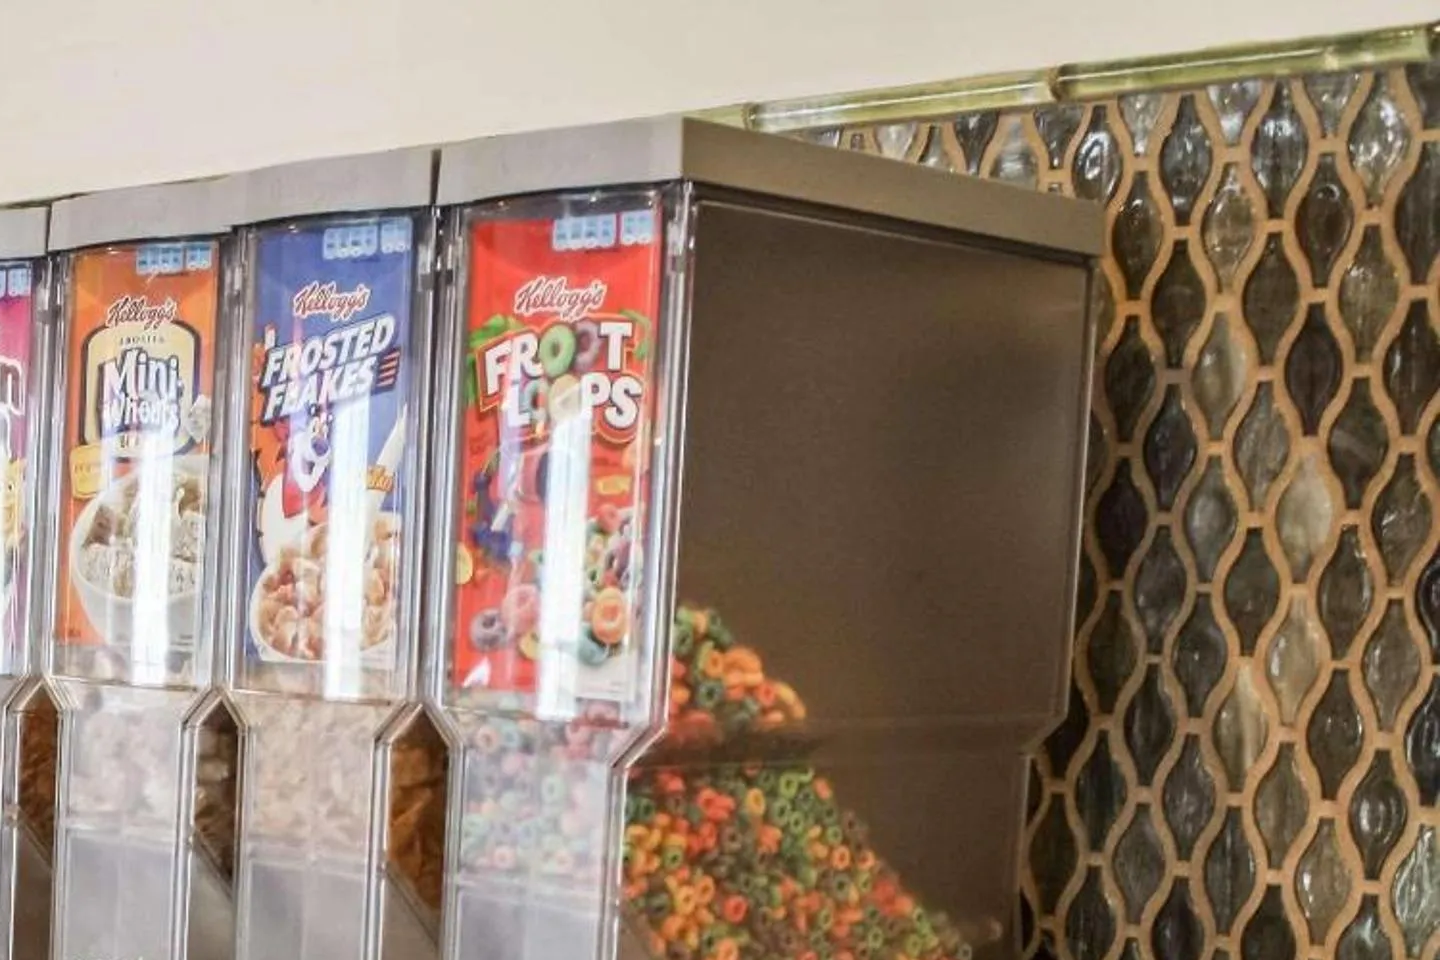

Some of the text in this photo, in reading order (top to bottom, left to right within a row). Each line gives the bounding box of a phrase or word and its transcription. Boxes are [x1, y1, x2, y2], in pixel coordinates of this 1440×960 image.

[107, 298, 176, 331] Kellogg's
[294, 282, 371, 321] Kellogg's
[515, 277, 606, 321] Kellogg's
[262, 316, 396, 388] FROSTED
[485, 320, 633, 395] FROOT
[263, 356, 378, 423] FLAKES
[507, 372, 643, 428] LOOPS
